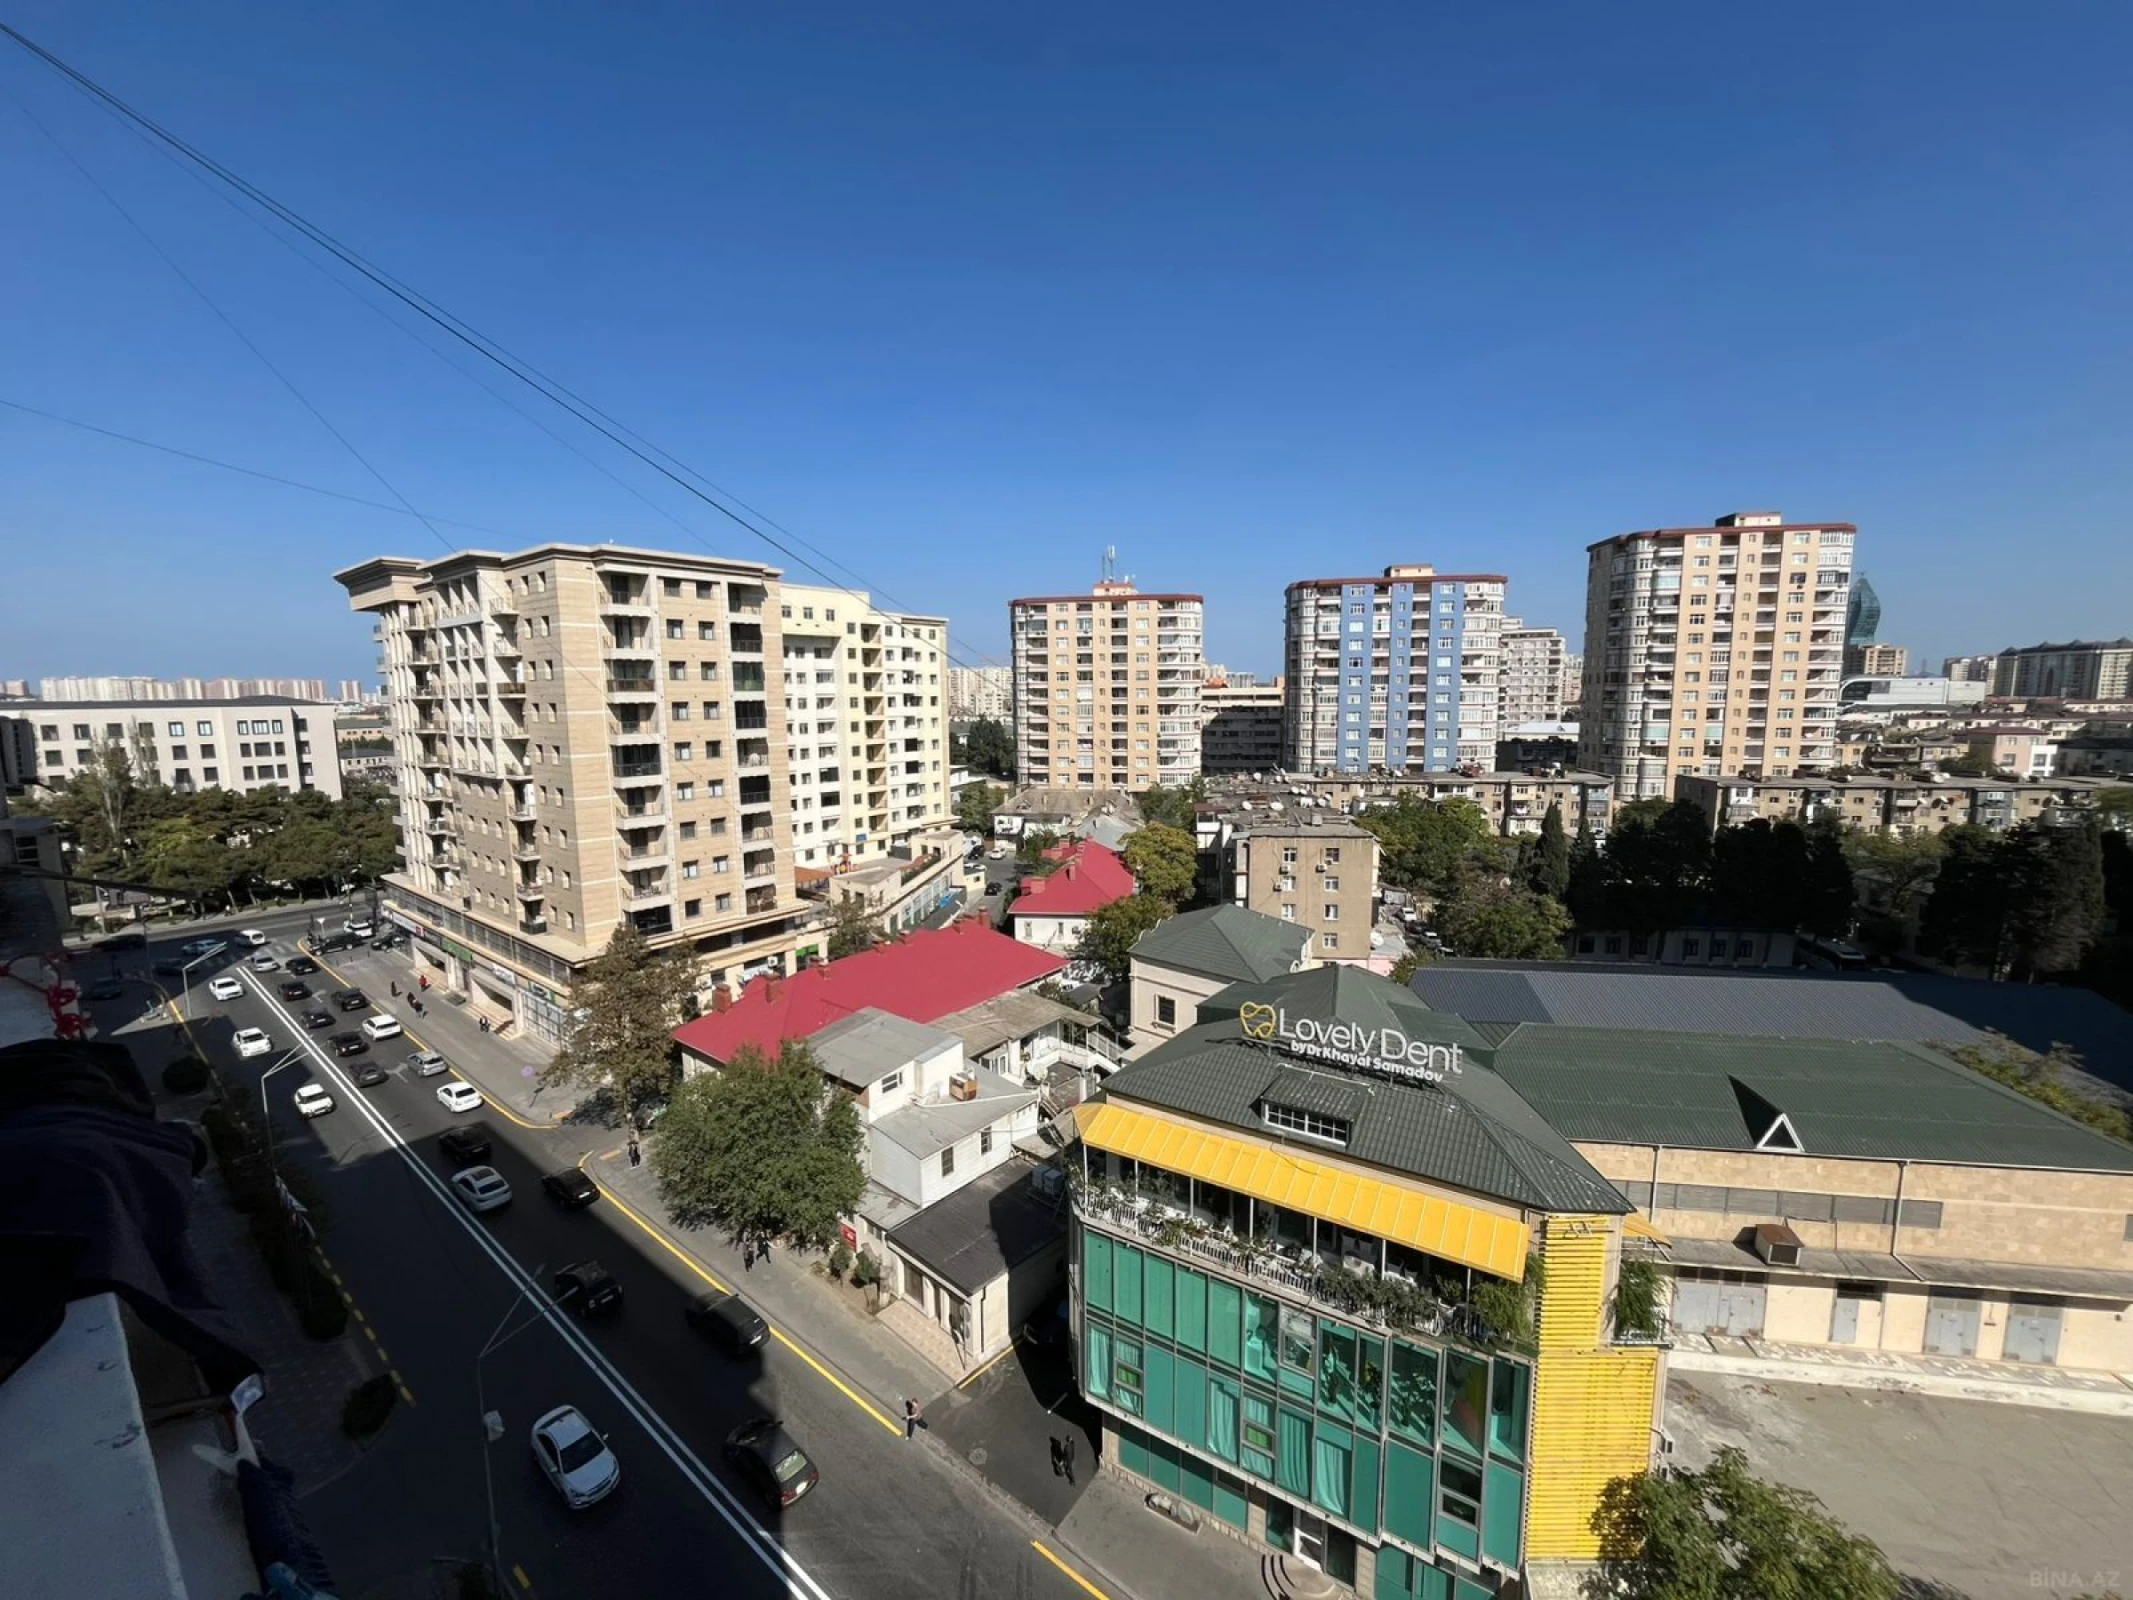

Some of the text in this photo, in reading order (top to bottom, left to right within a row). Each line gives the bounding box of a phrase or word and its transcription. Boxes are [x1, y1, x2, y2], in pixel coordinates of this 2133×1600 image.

[1279, 1008, 1463, 1074] Lovely Dent
[1372, 1056, 1444, 1083] Samadov
